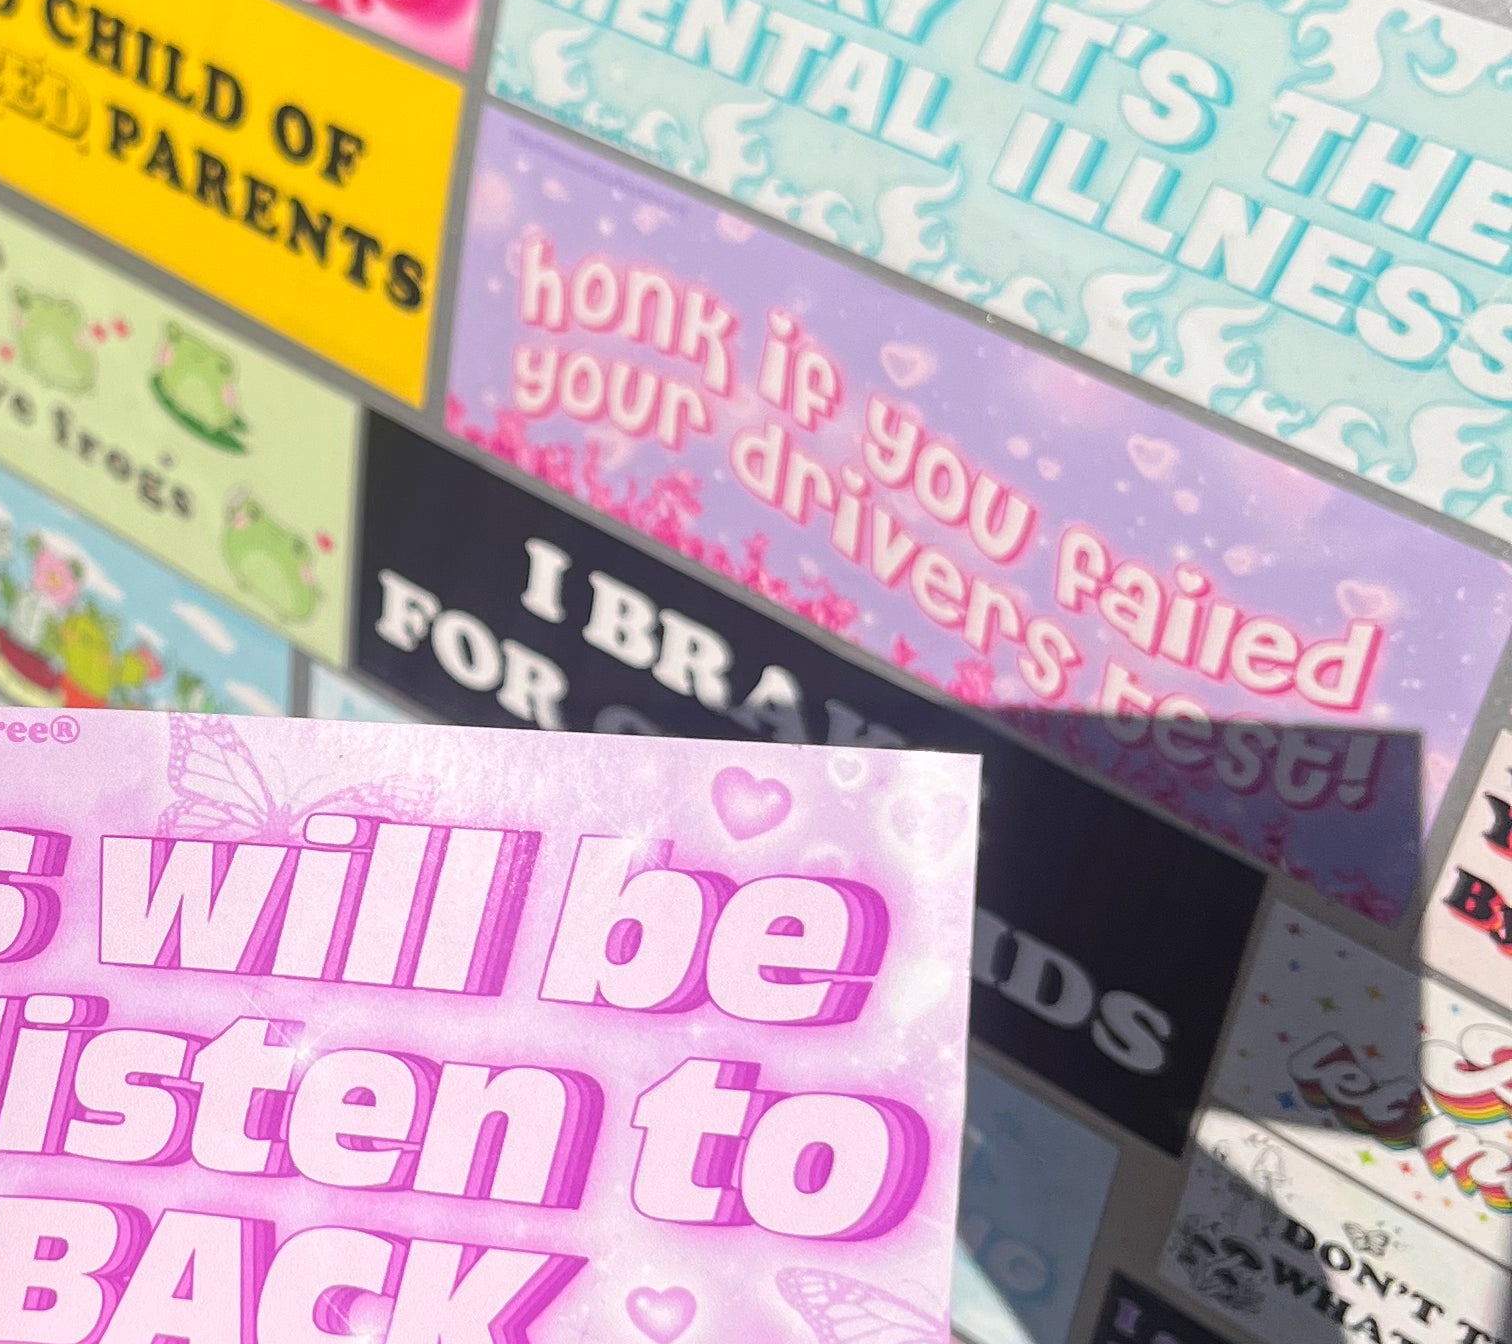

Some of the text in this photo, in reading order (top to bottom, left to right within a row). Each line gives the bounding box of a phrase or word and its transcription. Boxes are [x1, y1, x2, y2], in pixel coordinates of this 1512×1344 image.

[106, 102, 430, 315] PARENTS
[272, 102, 366, 188] OF
[50, 400, 196, 521] frogs
[517, 236, 1384, 710] honk if you failed
[375, 568, 570, 731] FOR
[512, 341, 1381, 812] your drivers test!
[521, 537, 571, 624] I
[97, 811, 542, 998] will
[538, 832, 891, 1027] be
[975, 924, 1172, 1076] IDS
[630, 1055, 932, 1243] to
[1282, 1217, 1446, 1327] DON'T
